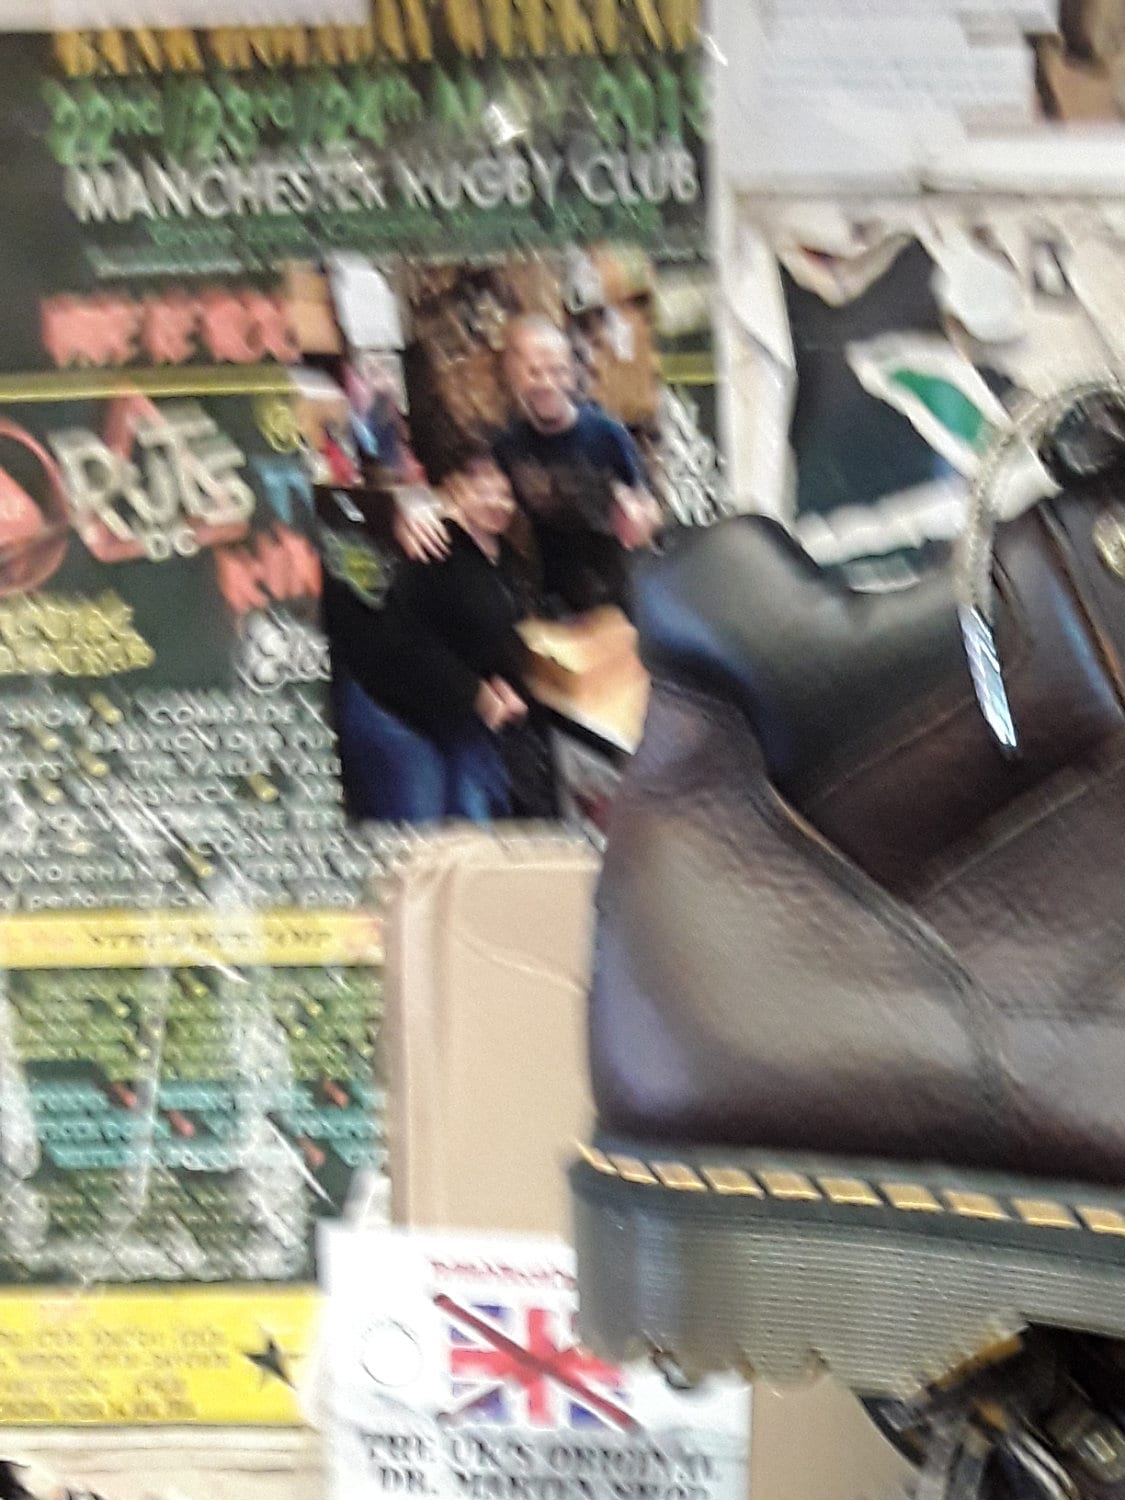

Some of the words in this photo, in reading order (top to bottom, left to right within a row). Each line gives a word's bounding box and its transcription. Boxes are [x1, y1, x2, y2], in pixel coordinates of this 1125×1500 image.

[64, 152, 386, 222] MANCHESTER
[394, 146, 562, 210] RUGBY
[570, 148, 698, 206] CLUB
[360, 1430, 437, 1464] THE
